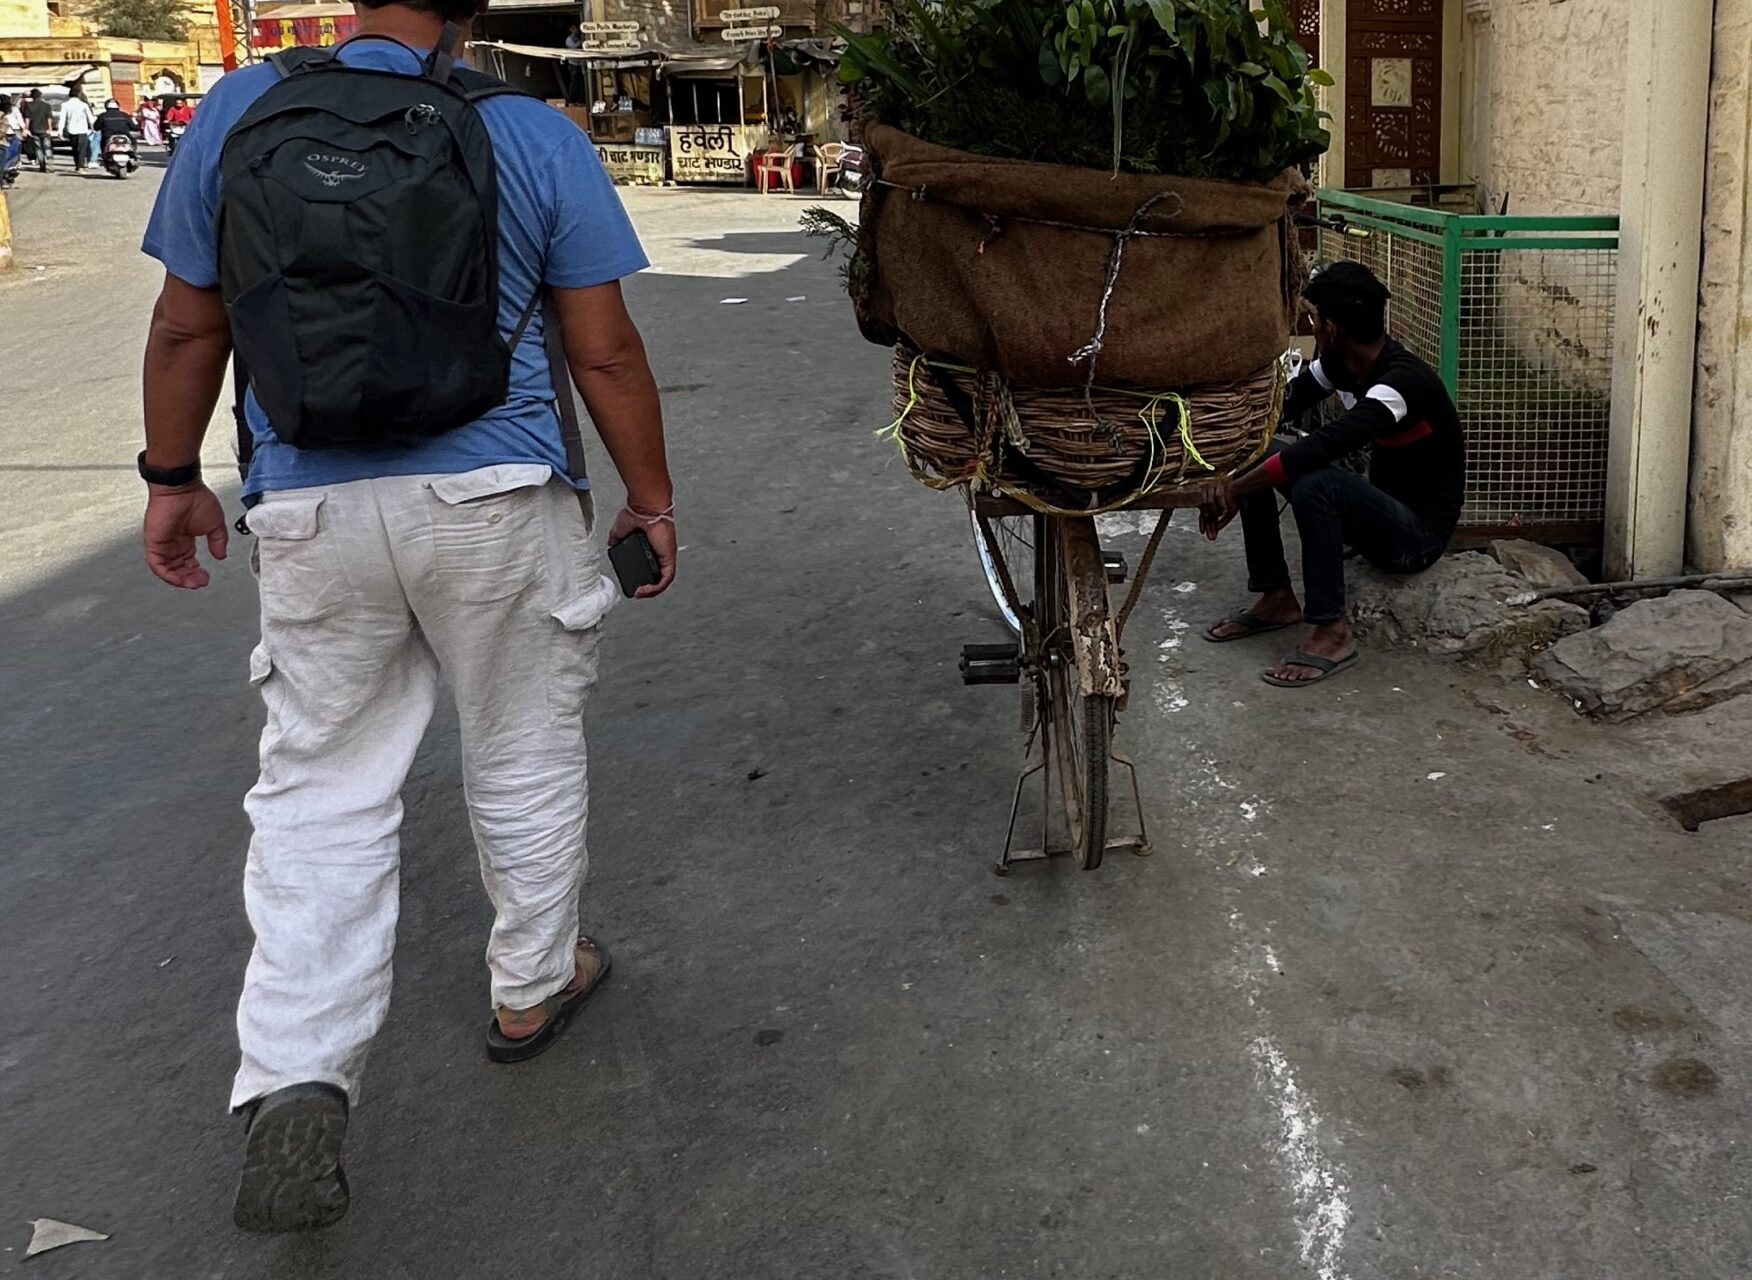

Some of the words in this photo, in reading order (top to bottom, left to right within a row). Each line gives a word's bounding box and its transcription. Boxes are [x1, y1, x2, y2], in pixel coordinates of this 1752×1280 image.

[676, 125, 740, 157] हवेली
[306, 153, 370, 172] OSPREY
[676, 156, 701, 169] चाट
[703, 156, 745, 171] भण्डार
